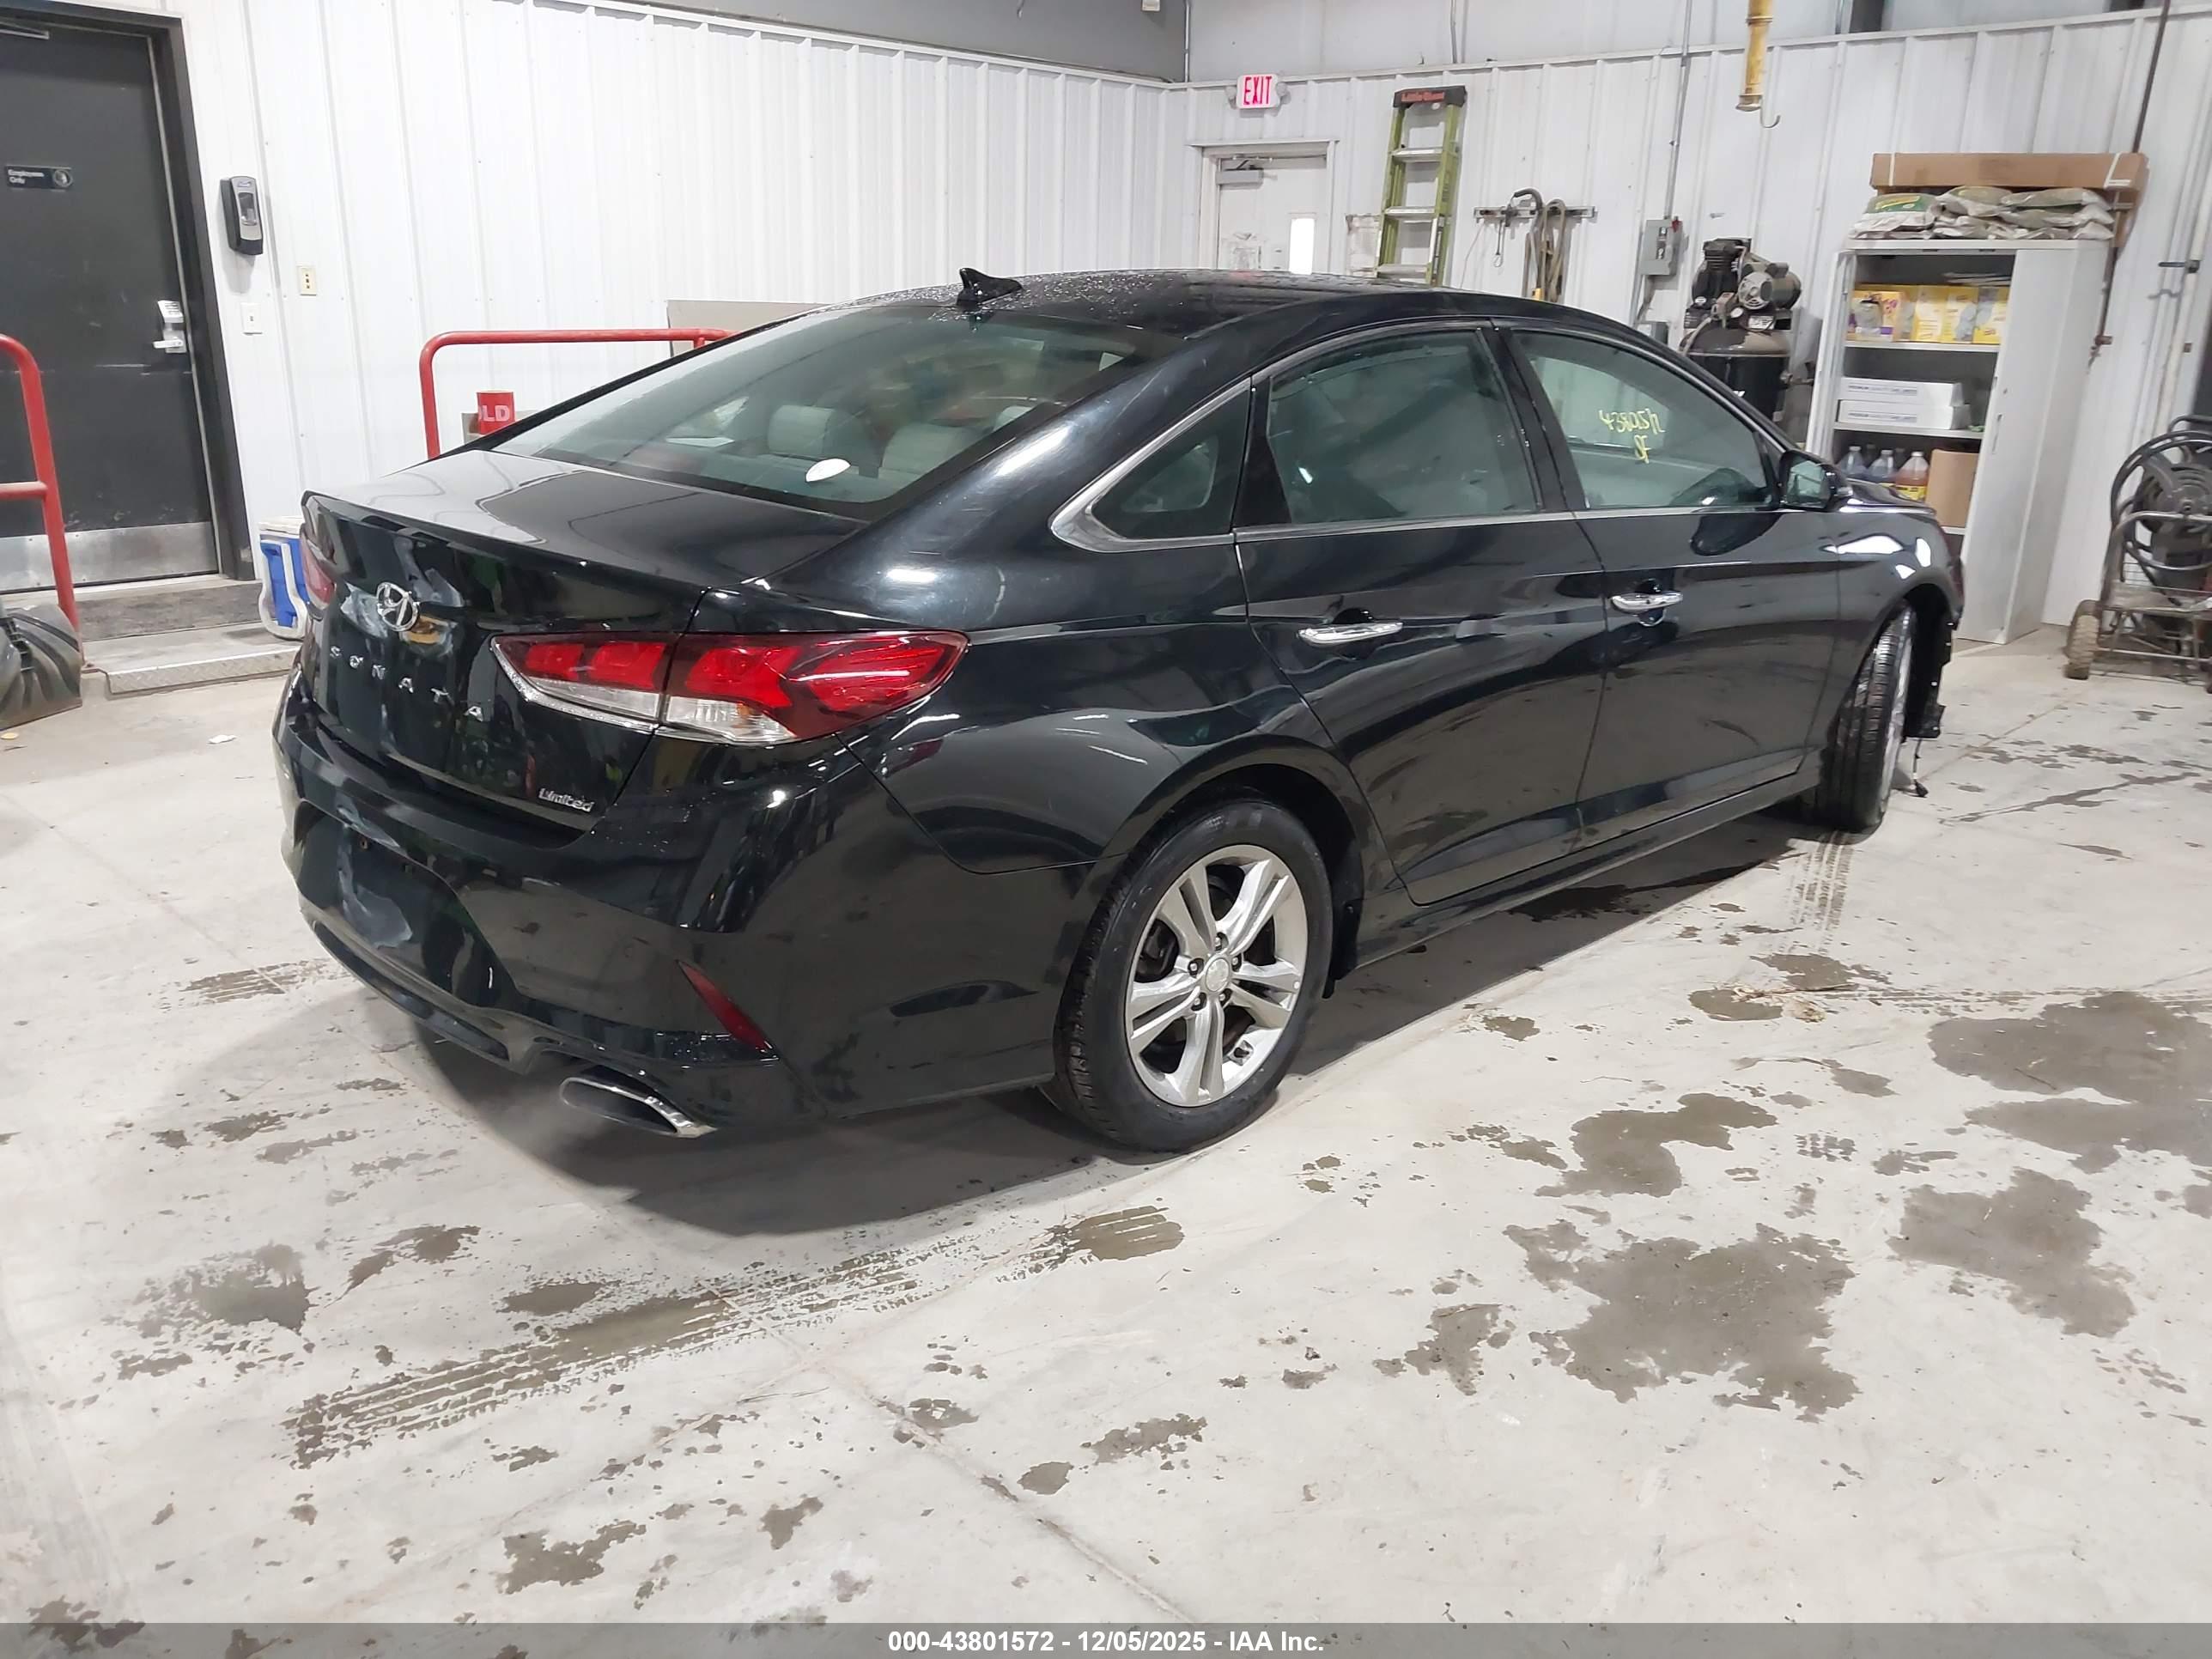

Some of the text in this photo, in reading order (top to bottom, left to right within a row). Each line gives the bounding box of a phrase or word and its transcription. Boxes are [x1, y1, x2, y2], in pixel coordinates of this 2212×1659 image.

[1243, 76, 1273, 105] EXIT
[478, 404, 510, 422] LD
[330, 646, 483, 722] SONATA
[538, 787, 595, 812] Limited
